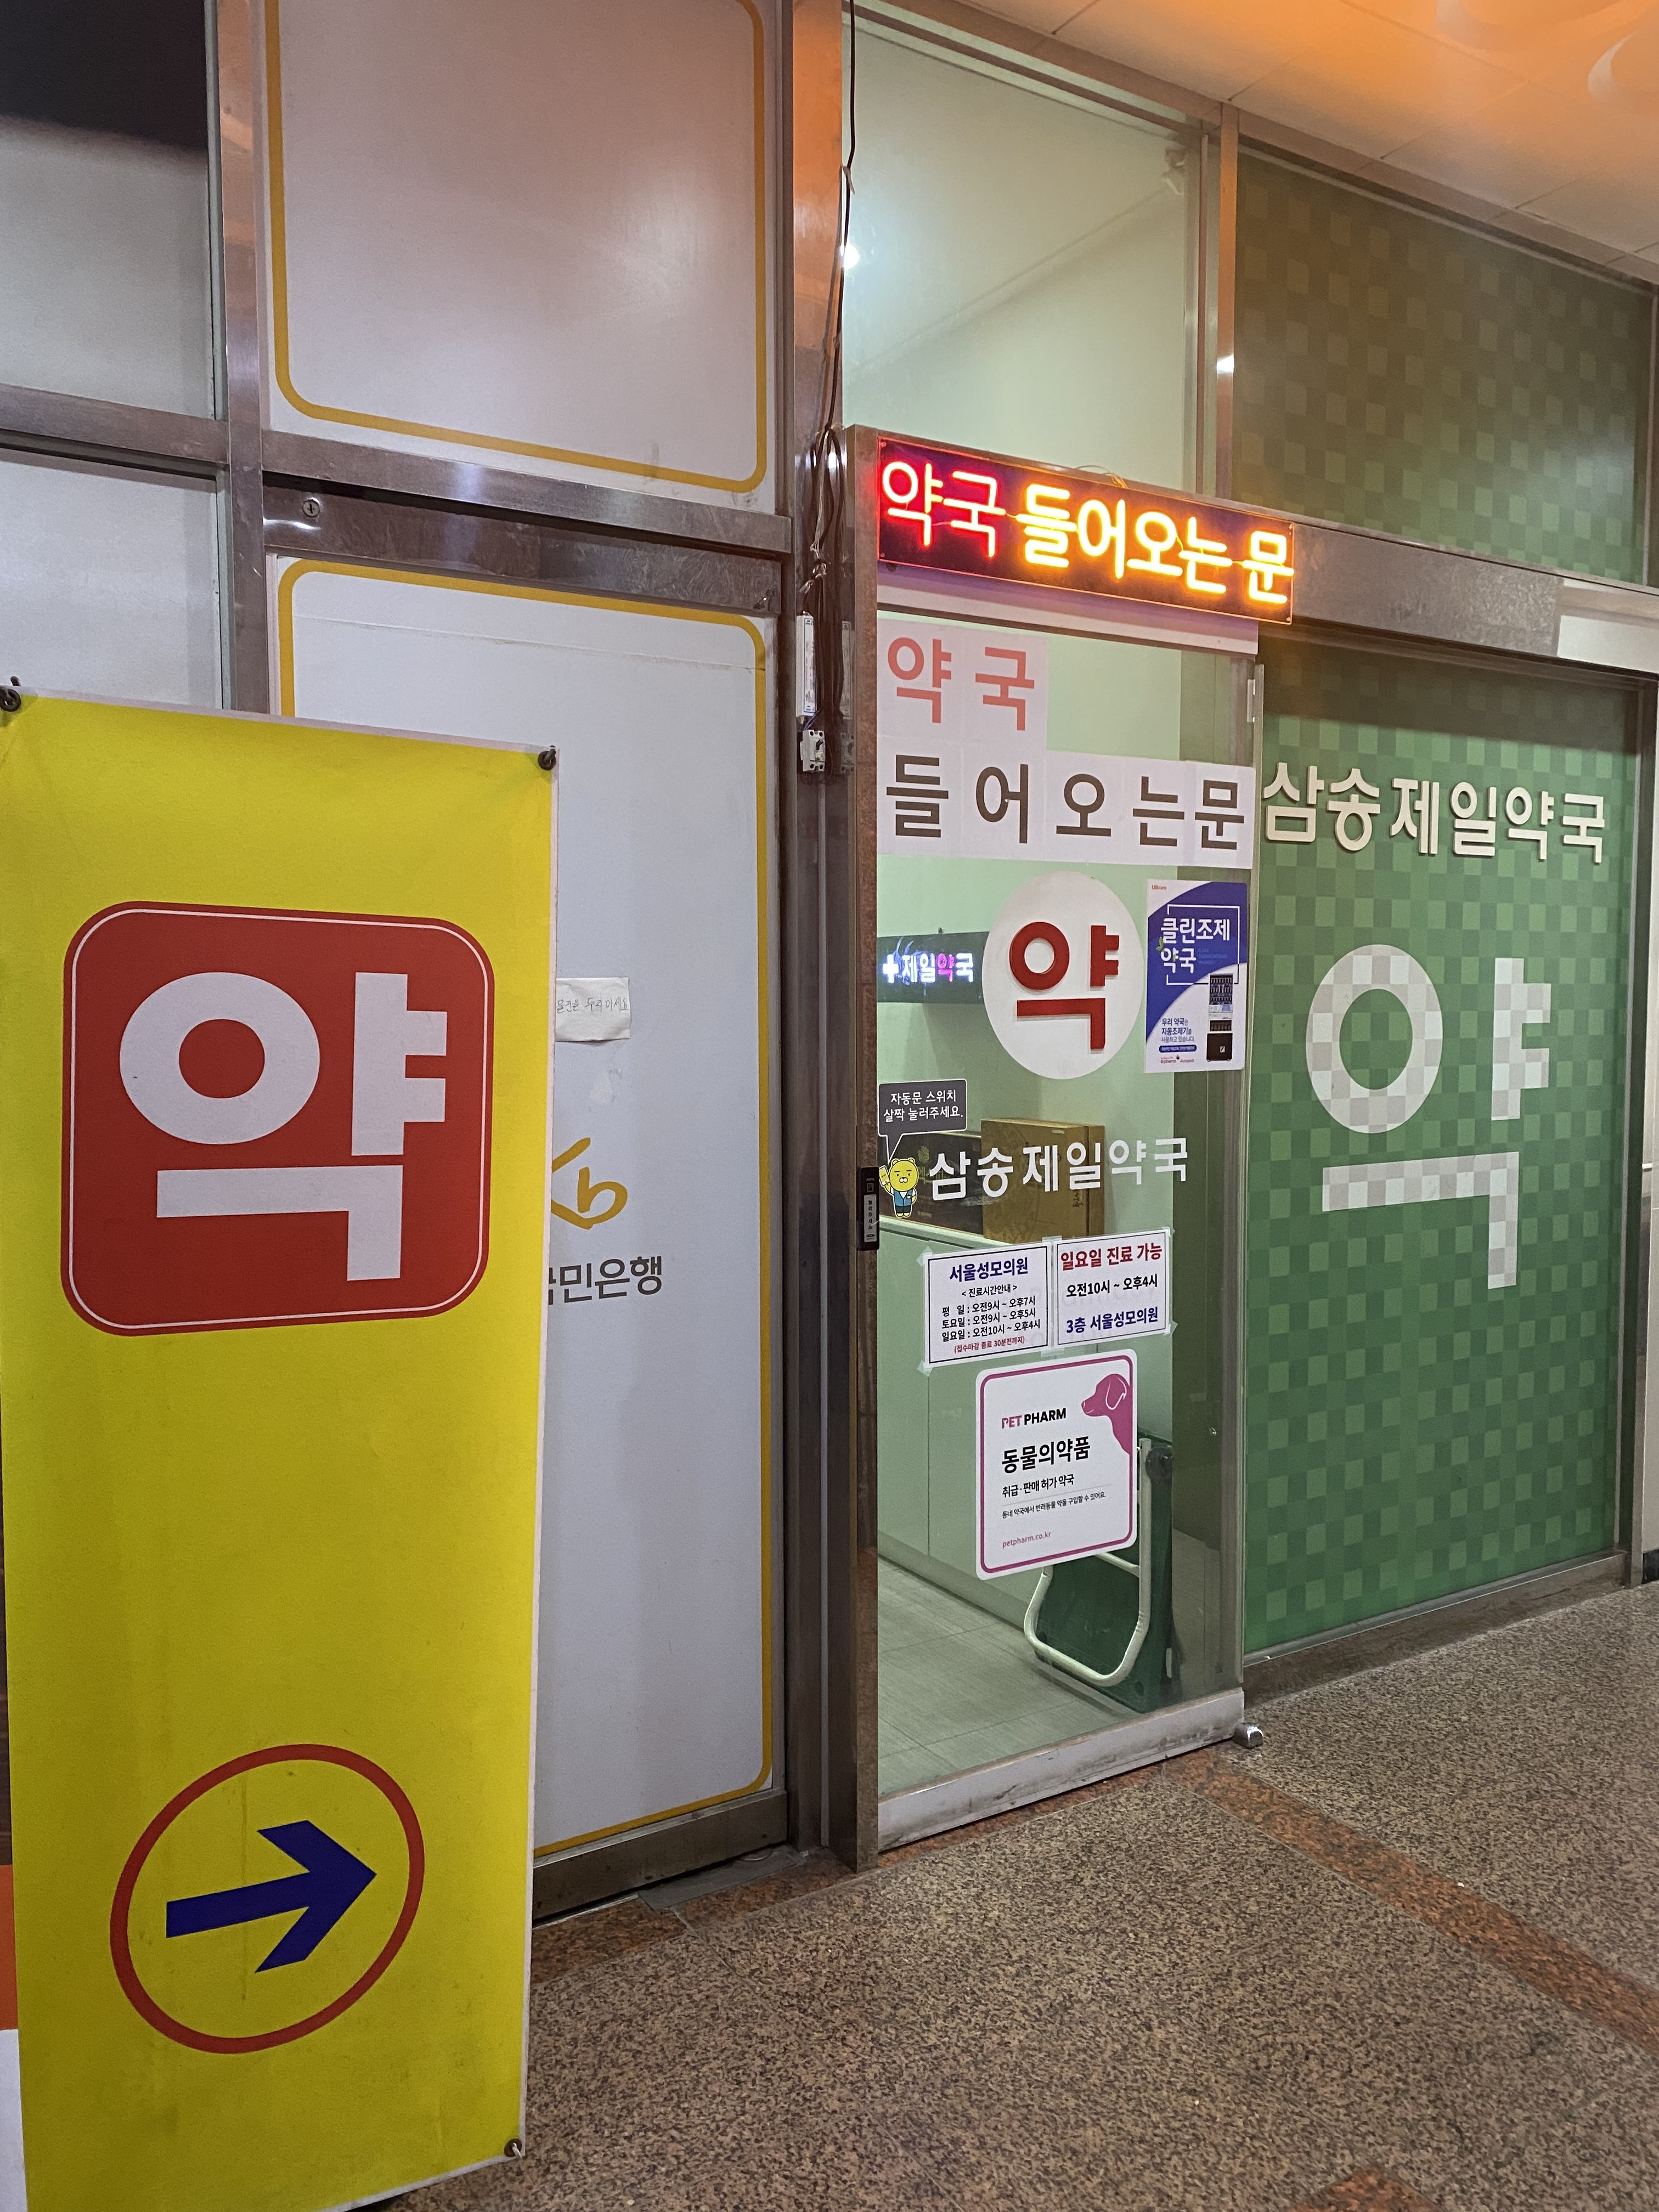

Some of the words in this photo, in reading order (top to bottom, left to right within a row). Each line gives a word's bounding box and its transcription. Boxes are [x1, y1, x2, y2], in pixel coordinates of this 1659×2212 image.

[882, 461, 1005, 557] 약국
[1017, 483, 1233, 594] 들어오는
[1243, 531, 1294, 603] 문
[888, 636, 1034, 731] 약국
[1262, 761, 1605, 863] 삼송제일약국
[1161, 918, 1230, 944] 클린조제
[1160, 947, 1197, 973] 약국
[1009, 921, 1120, 1049] 약
[1162, 1018, 1172, 1026] 우리
[890, 1091, 922, 1105] 자동문
[926, 1089, 956, 1103] 스위치
[883, 1108, 905, 1122] 살짝
[908, 1105, 963, 1121] 눌러주세요.
[1306, 944, 1551, 1290] 약
[119, 972, 448, 1281] 약
[929, 1137, 1188, 1201] 삼송제일약국
[950, 1257, 1028, 1282] 서울성모의원
[1060, 1248, 1102, 1271] 일요일
[1107, 1246, 1133, 1265] 진료
[1137, 1243, 1162, 1261] 가능
[549, 1255, 662, 1306] 민은행
[969, 1284, 1011, 1297] 진료시간안내
[1066, 1279, 1110, 1297] 오전10시
[1123, 1273, 1158, 1290] 오후4시
[972, 1300, 1000, 1312] 오전9시
[1009, 1295, 1035, 1308] 오후7시
[942, 1317, 965, 1329] 토요일
[973, 1312, 1000, 1324] 오전9시
[1009, 1307, 1036, 1320] 오후5시
[942, 1329, 965, 1342] 일요일
[973, 1324, 1005, 1337] 오전10시
[1014, 1319, 1040, 1331] 오후4시
[1066, 1317, 1086, 1333] 3층
[1090, 1306, 1158, 1330] 서울성모의원
[981, 1341, 992, 1349] 종료
[1002, 1415, 1022, 1429] PET
[1024, 1408, 1066, 1425] PHARM
[1002, 1436, 1090, 1474] 동물의약품
[1041, 1477, 1056, 1490] 허가
[1058, 1474, 1074, 1486] 약국
[1002, 1510, 1013, 1519] 동네
[1068, 1496, 1083, 1505] 구입할
[1002, 1531, 1051, 1549] petpharm.co.kr
